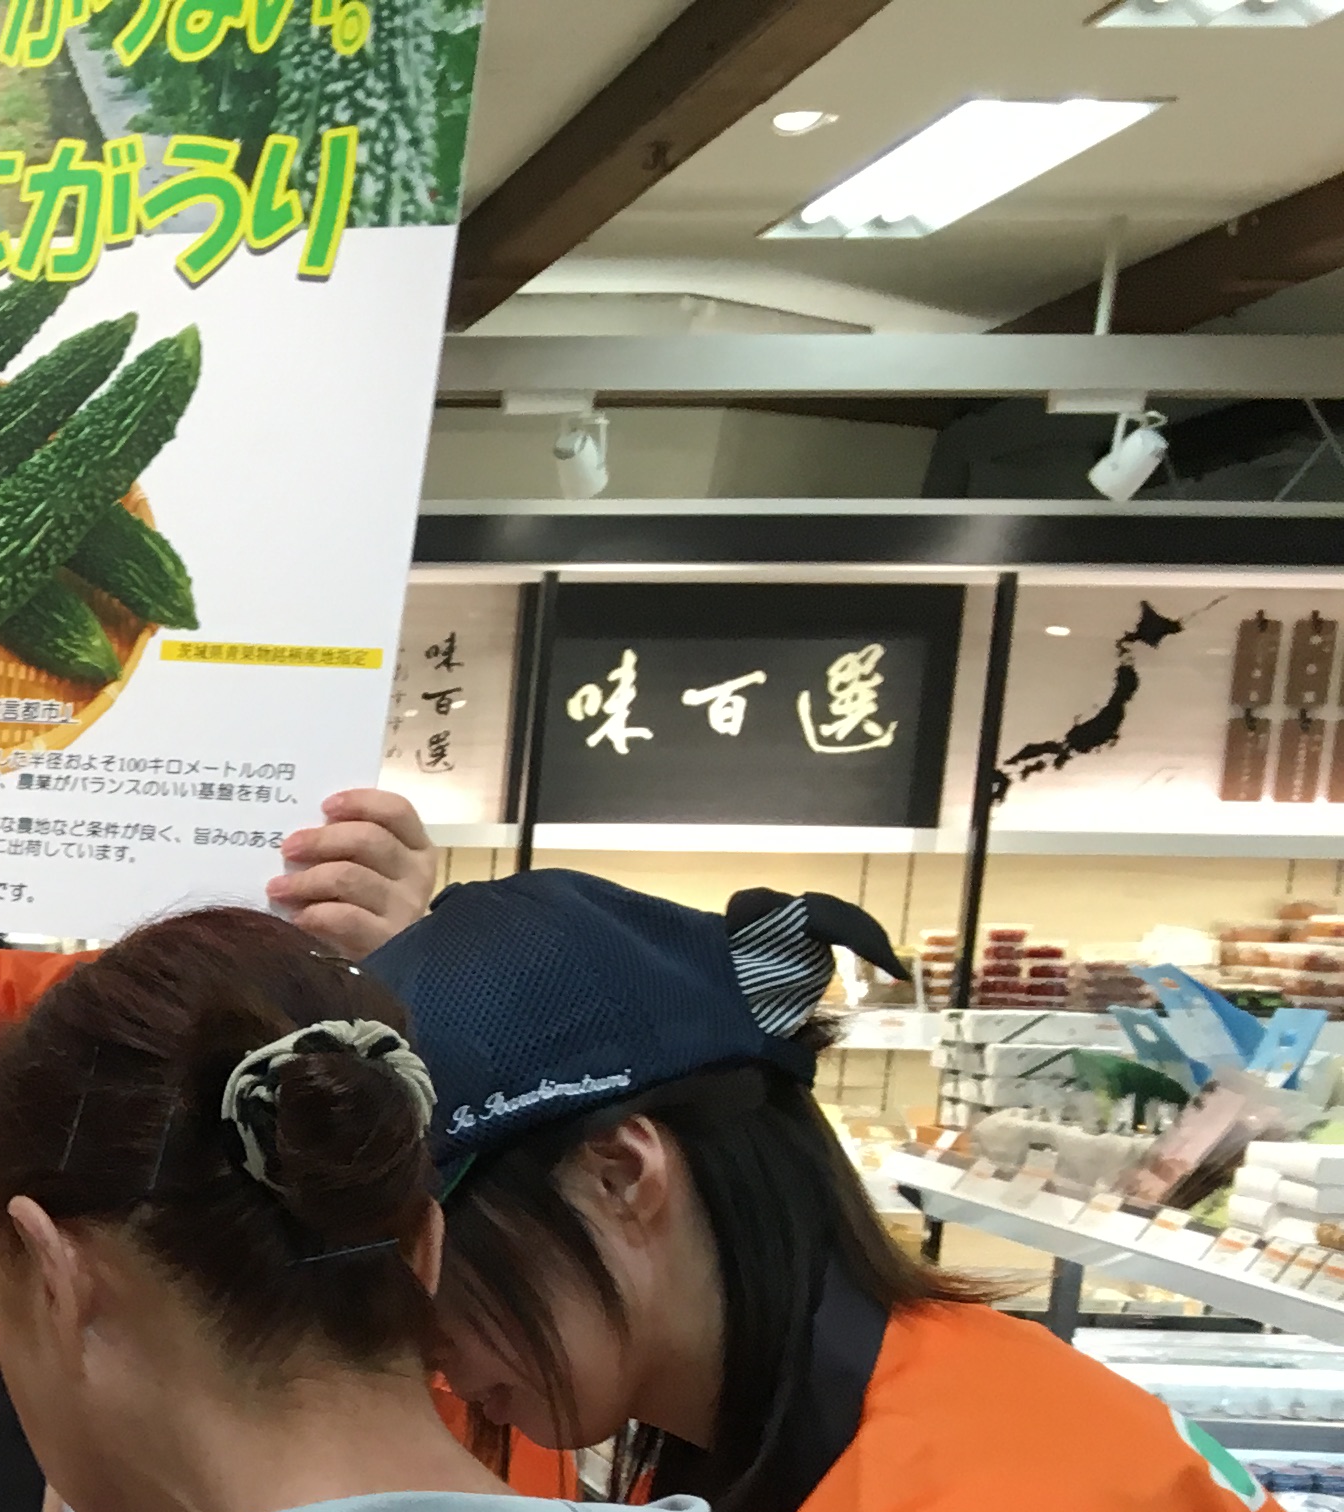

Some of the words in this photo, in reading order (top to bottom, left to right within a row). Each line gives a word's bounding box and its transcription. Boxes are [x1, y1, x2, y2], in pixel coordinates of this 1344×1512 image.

[416, 631, 465, 774] 味百選
[567, 641, 899, 754] 味百選
